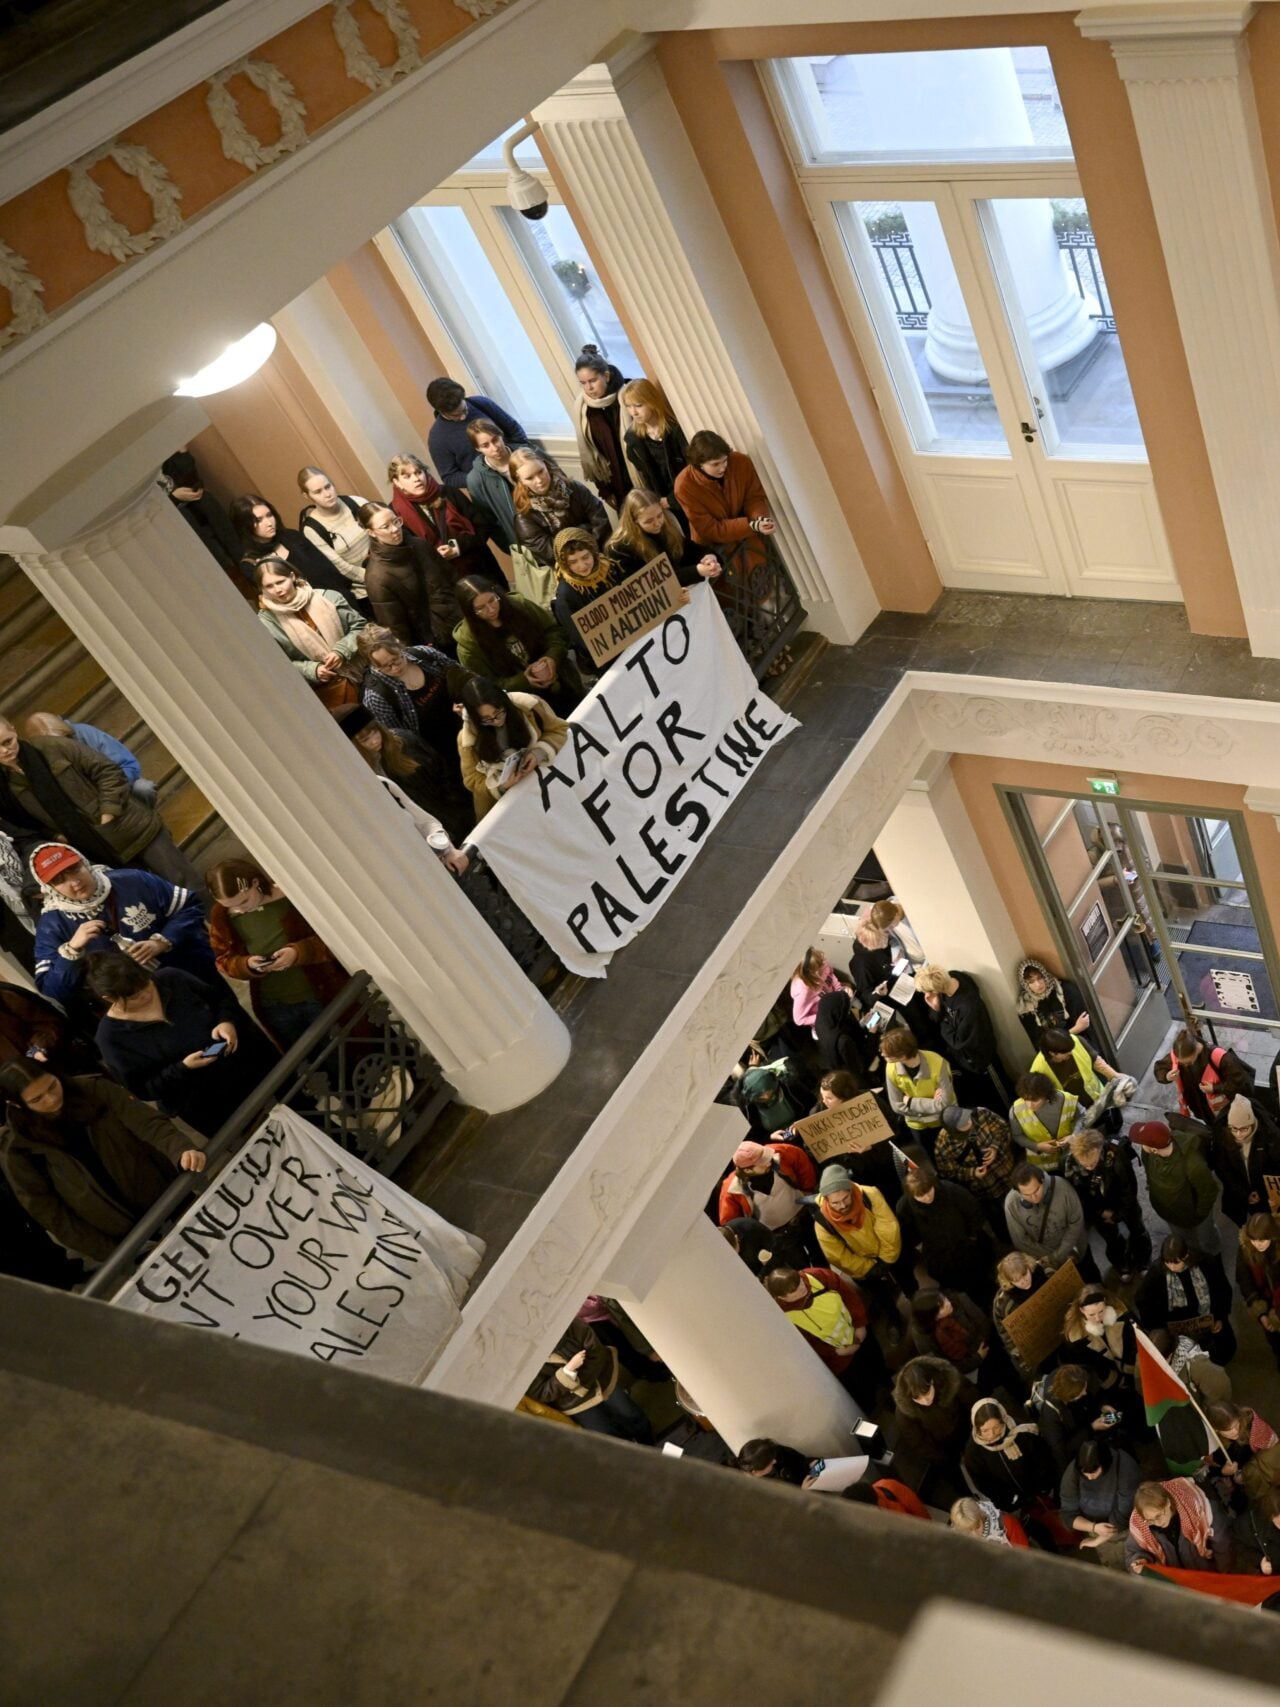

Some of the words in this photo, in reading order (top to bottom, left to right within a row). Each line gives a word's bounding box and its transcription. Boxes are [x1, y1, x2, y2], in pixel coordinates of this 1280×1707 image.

[577, 603, 609, 634] BLOOD
[590, 633, 609, 657] IN
[535, 614, 690, 812] AALTO
[581, 701, 706, 846] FOR
[566, 698, 782, 953] PALESTINE
[810, 1141, 833, 1156] FOR
[829, 1115, 884, 1146] PALESTINE
[832, 1098, 879, 1126] STUDENTS
[252, 1238, 348, 1329] YOUR
[318, 1168, 374, 1234] VOIC
[310, 1209, 422, 1361] ALESTIN
